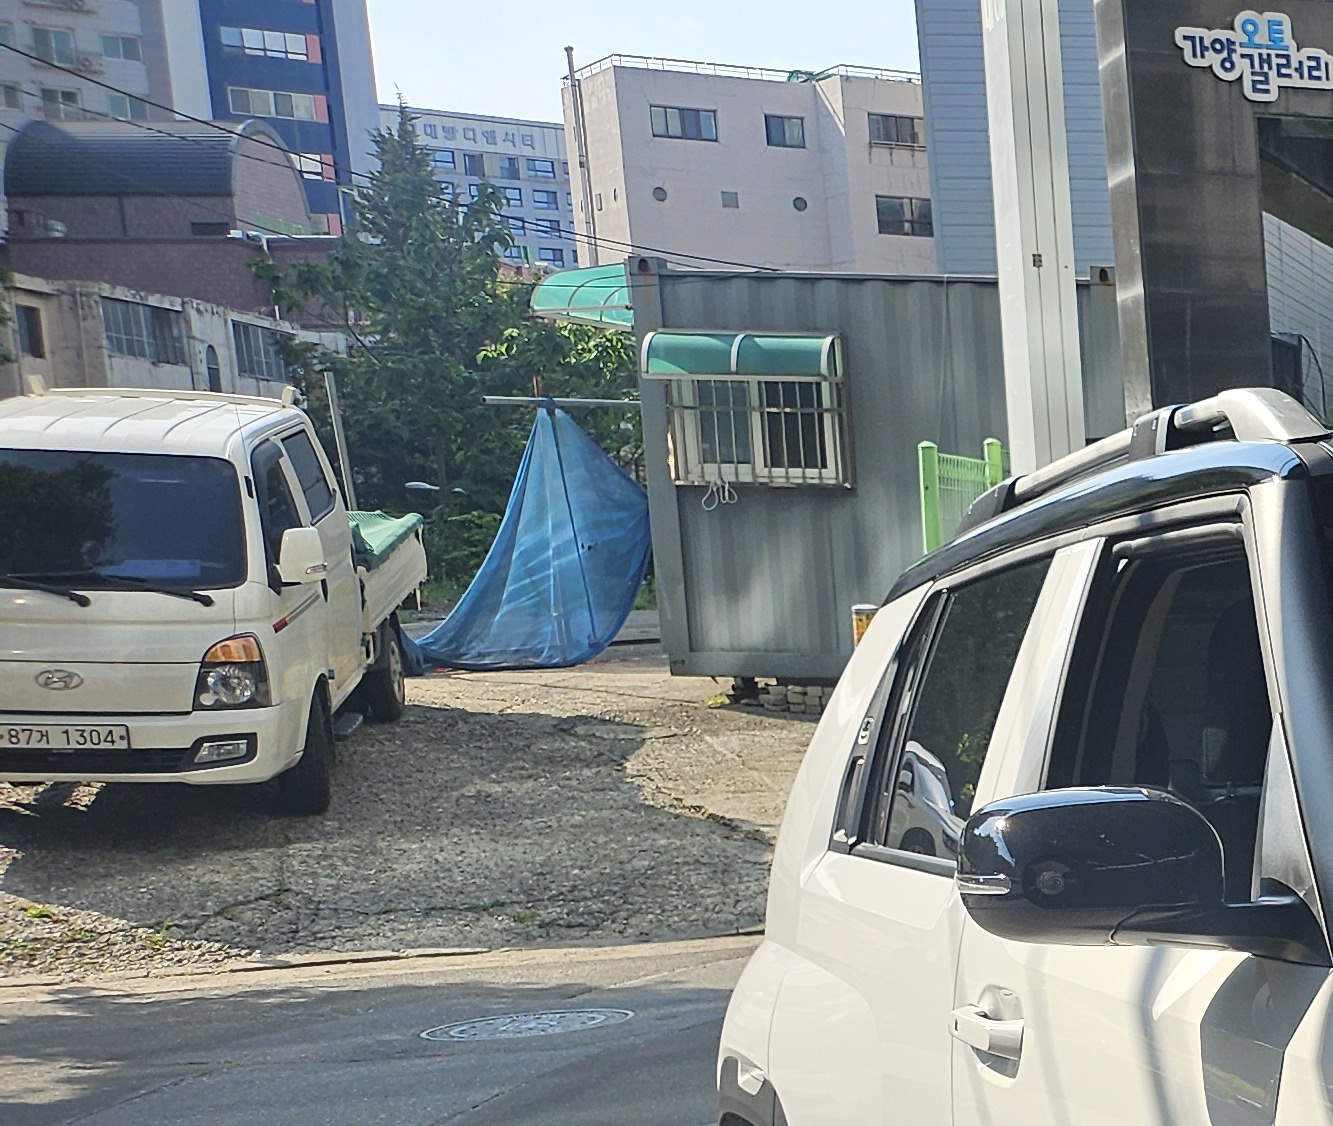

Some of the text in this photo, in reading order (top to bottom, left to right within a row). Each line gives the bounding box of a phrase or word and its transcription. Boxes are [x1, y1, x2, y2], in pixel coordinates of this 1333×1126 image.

[1240, 18, 1290, 50] 오토
[1183, 34, 1237, 73] 가양
[1240, 52, 1330, 94] 갤러리
[8, 728, 117, 746] 87거 1304
